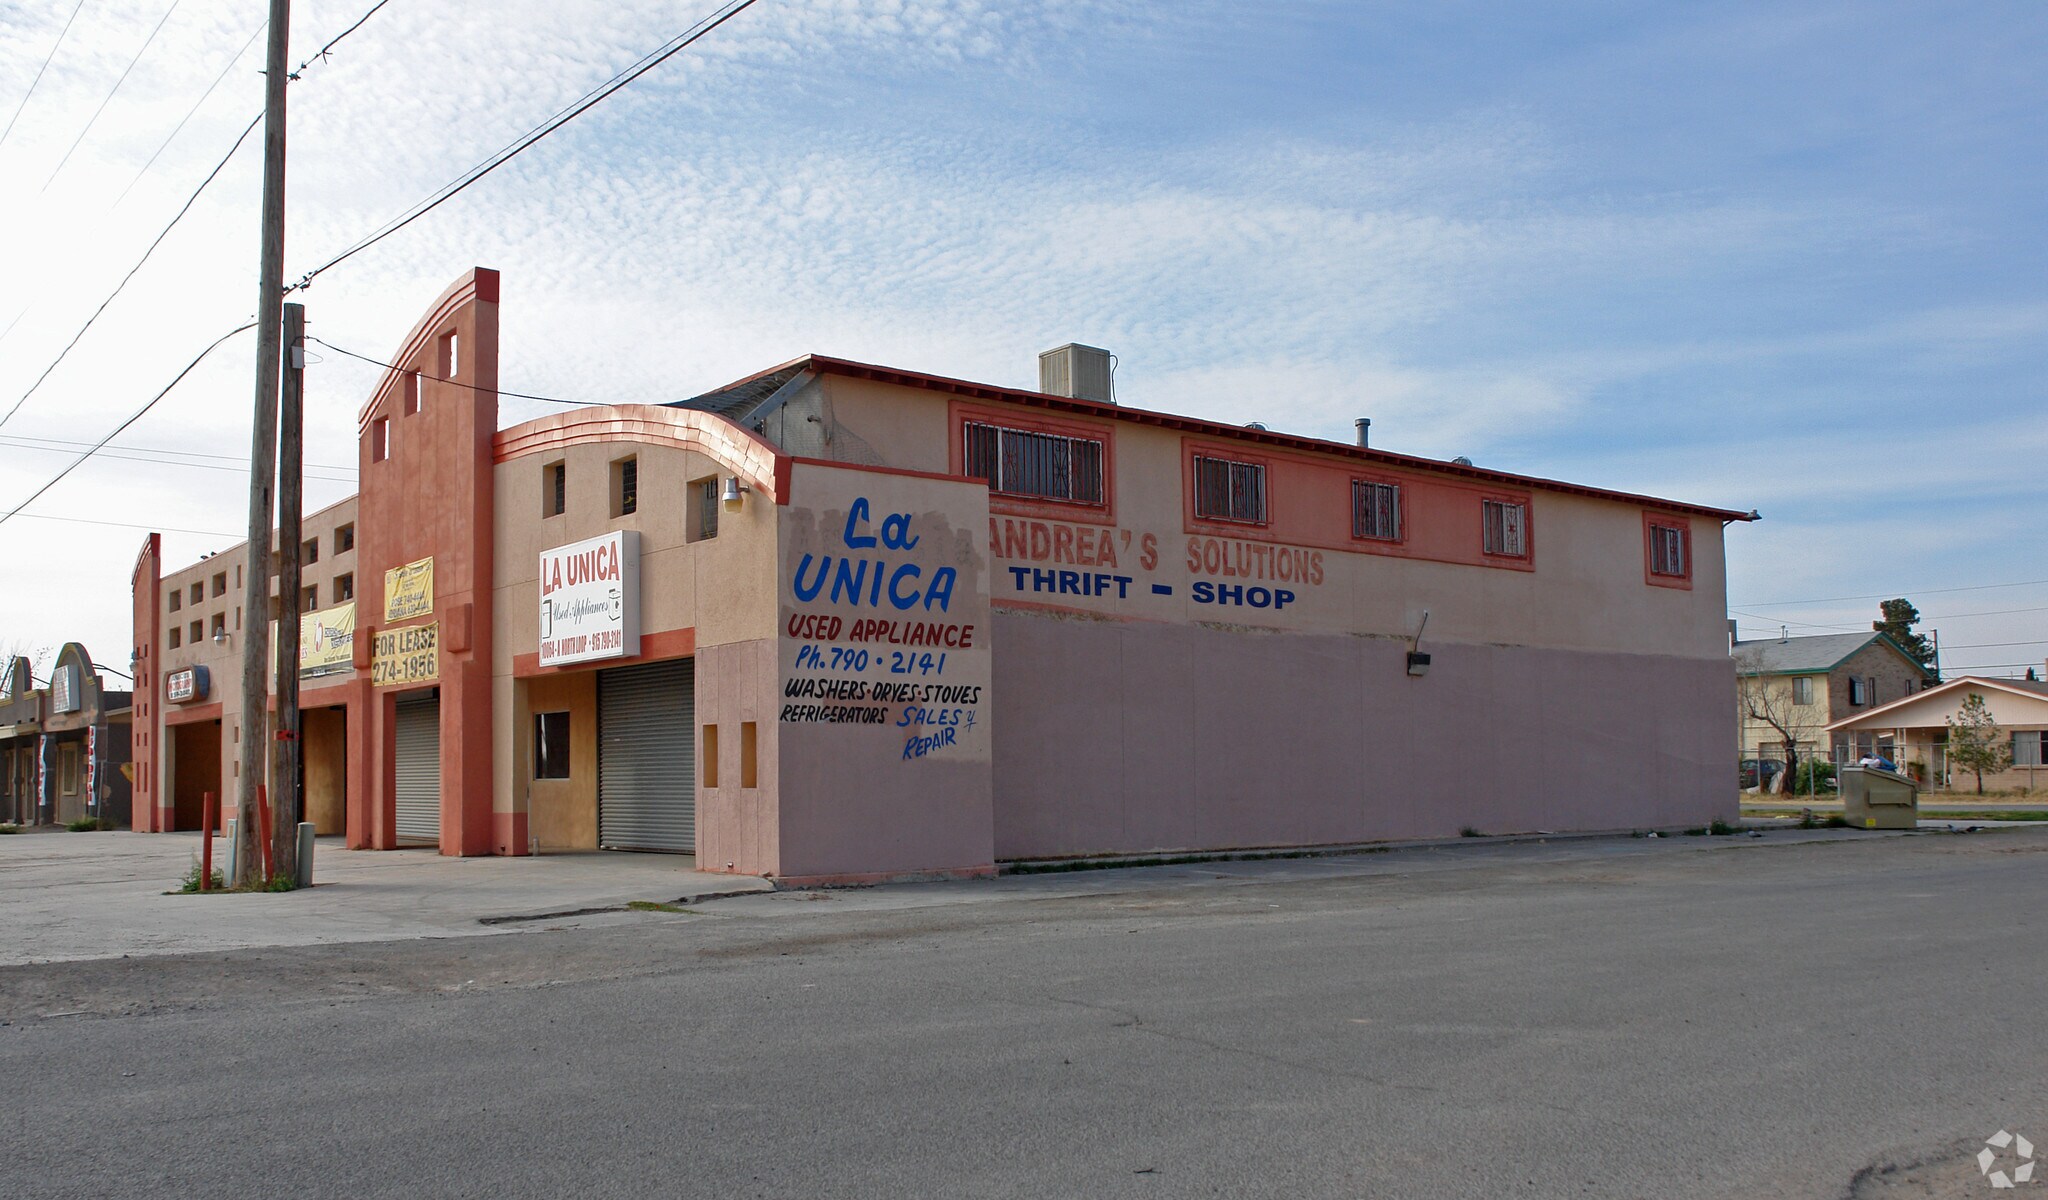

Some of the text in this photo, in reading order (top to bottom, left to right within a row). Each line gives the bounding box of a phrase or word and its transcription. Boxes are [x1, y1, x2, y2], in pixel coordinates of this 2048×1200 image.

[843, 497, 920, 551] La
[543, 541, 620, 596] LA UNICA
[1186, 537, 1325, 587] SOLUTIONS
[793, 553, 957, 613] UNICA
[1009, 566, 1133, 600] THRIFT
[1191, 581, 1296, 610] SHOP
[553, 597, 609, 625] Used Appliances
[373, 634, 395, 657] FOR
[400, 627, 435, 654] LEASE
[787, 613, 974, 648] USED APPLIANCE
[373, 653, 434, 683] 274-1956
[890, 651, 946, 675] 2141
[779, 704, 888, 725] REFRIGERATORS
[896, 705, 963, 728] SALES
[902, 727, 956, 761] REPAIR
